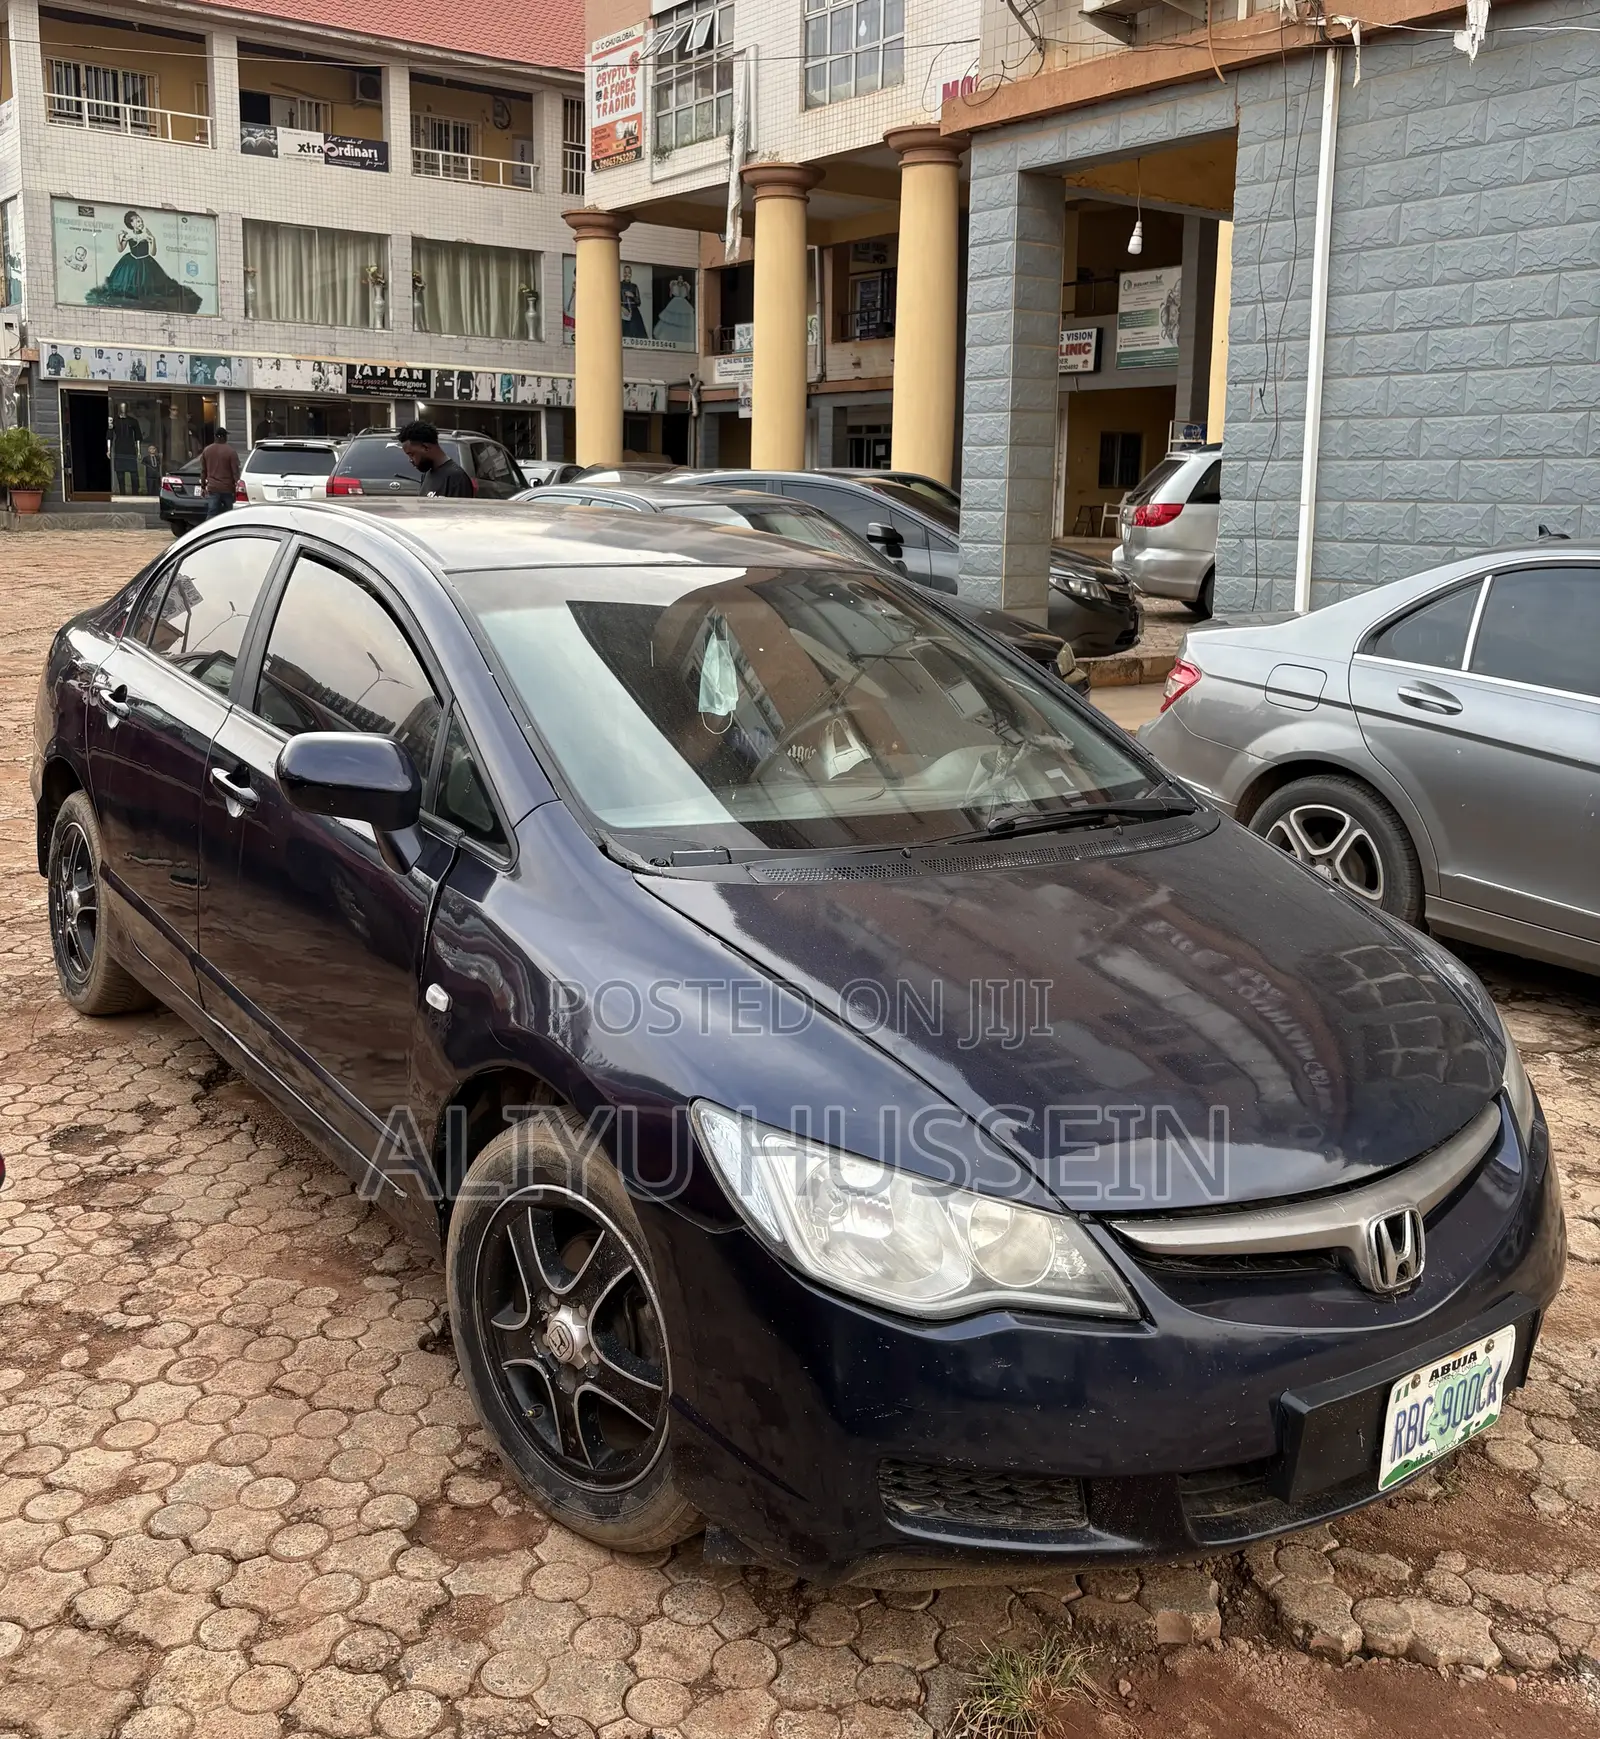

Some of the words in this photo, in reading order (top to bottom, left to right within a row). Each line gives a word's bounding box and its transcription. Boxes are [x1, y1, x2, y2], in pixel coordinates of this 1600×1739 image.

[596, 65, 627, 88] CRYPTO
[610, 76, 636, 99] FOREX
[596, 92, 636, 118] TRADING
[1067, 331, 1092, 341] VISION
[1060, 342, 1092, 356] LINIC
[393, 379, 427, 389] designers
[1429, 1351, 1477, 1382] ABUJA
